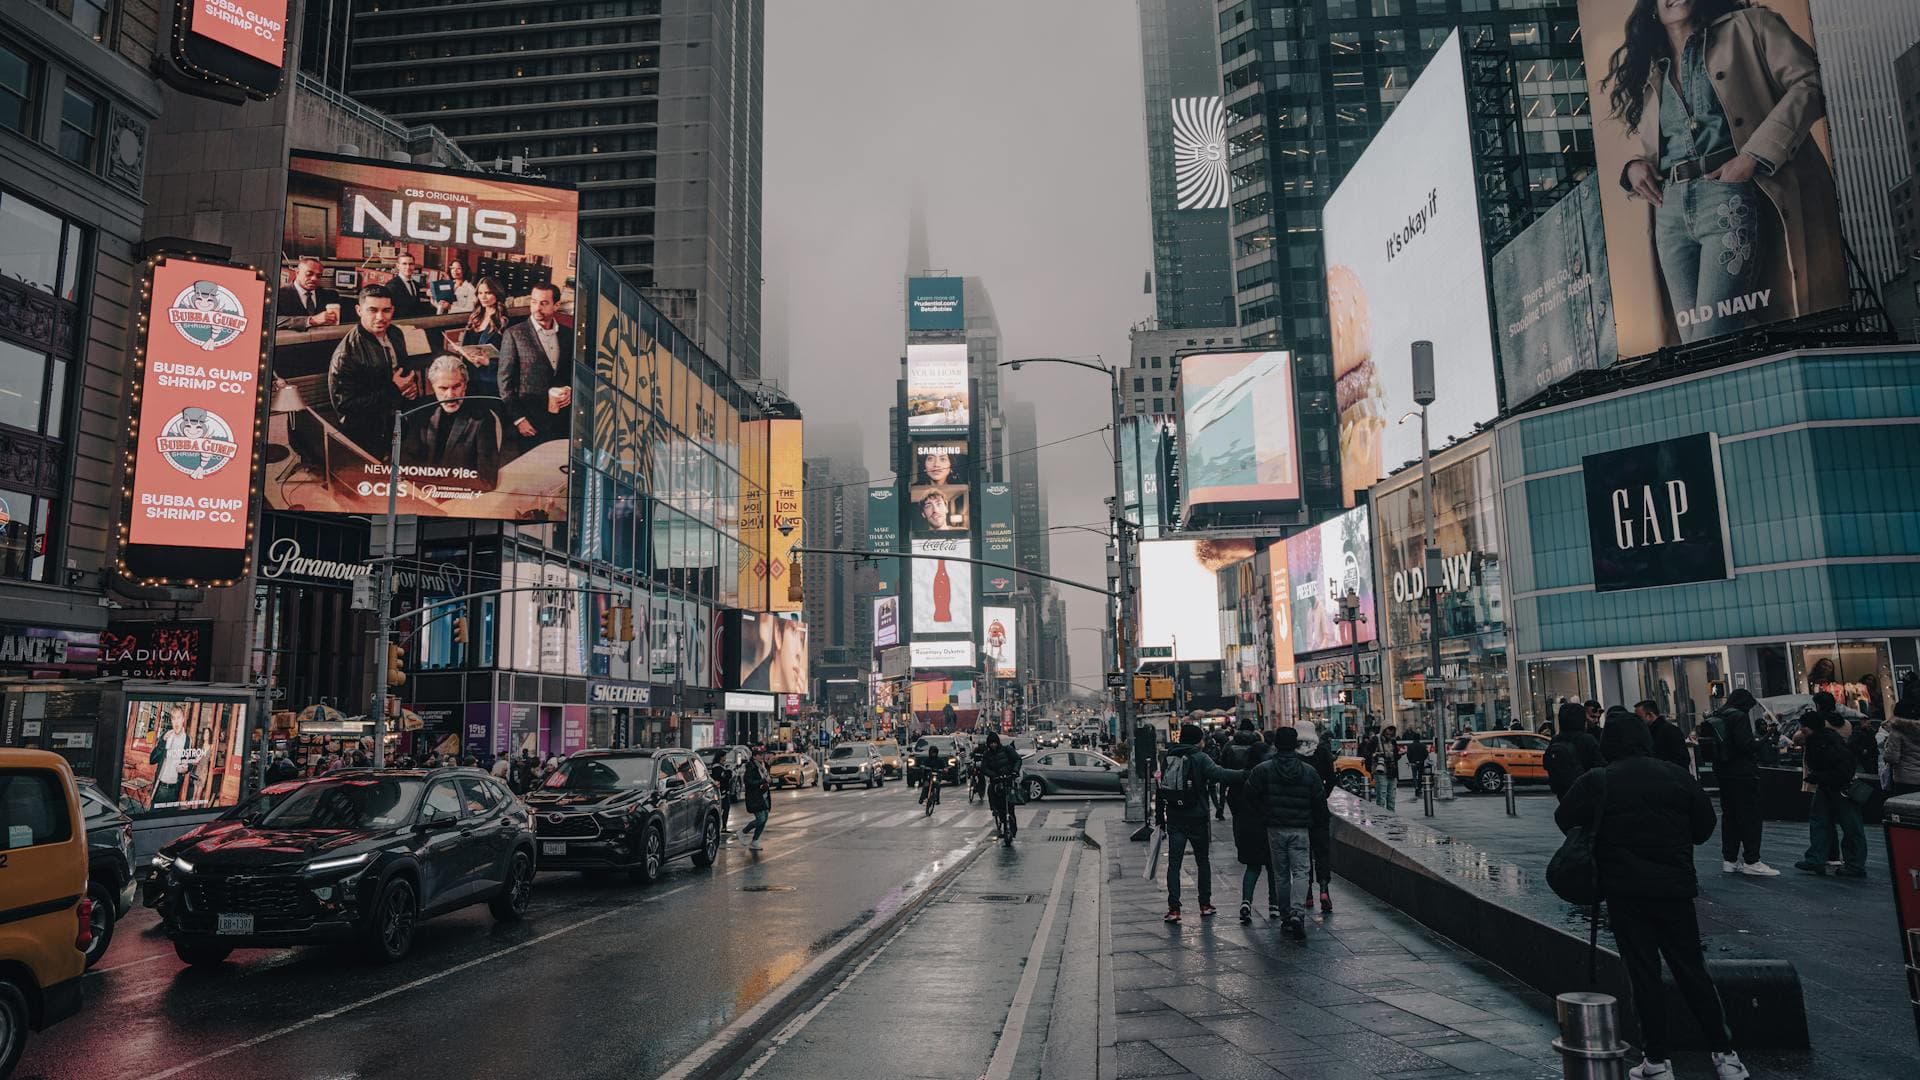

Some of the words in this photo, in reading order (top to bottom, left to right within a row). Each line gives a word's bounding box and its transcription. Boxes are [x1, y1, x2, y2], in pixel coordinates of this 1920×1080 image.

[205, 0, 244, 17] UBBA
[246, 10, 281, 32] GUMP
[205, 4, 252, 30] SHRIMP
[254, 26, 274, 41] CO.
[405, 189, 424, 198] CBS
[426, 191, 470, 203] ORIGINAL
[352, 194, 517, 249] NCIS
[1386, 232, 1402, 262] It's
[1403, 205, 1427, 244] okay
[1428, 188, 1437, 218] if
[1522, 286, 1543, 308] There
[1543, 278, 1556, 294] We
[1508, 310, 1540, 337] Stopping
[1540, 289, 1567, 318] Traffic
[1676, 305, 1713, 328] OLD
[1717, 289, 1771, 318] NAVY
[171, 309, 211, 324] BUBBA
[212, 312, 246, 329] GUMP
[153, 361, 206, 378] BUBBA
[208, 368, 252, 382] GUMP
[1536, 369, 1552, 386] OLD
[1552, 355, 1574, 377] NAVY
[158, 375, 216, 390] SHRIMP
[219, 381, 245, 394] CO.
[695, 402, 715, 436] THE
[160, 439, 200, 451] BUBBA
[201, 440, 235, 456] GUMP
[917, 446, 960, 455] SAMSUNG
[364, 464, 392, 475] NEW
[398, 465, 450, 477] MONDAY
[141, 493, 195, 508] BUBBA
[198, 497, 243, 510] GUMP
[776, 501, 797, 512] LION
[146, 506, 206, 521] SHRIMP
[208, 511, 236, 523] CO.
[773, 515, 800, 529] KING
[1612, 480, 1688, 550] GAP
[263, 538, 374, 580] Paramount
[1394, 567, 1423, 603] OLD
[1426, 551, 1473, 597] AVY
[97, 649, 191, 661] LADIUM
[122, 669, 190, 677] SQUARE
[1441, 663, 1460, 679] NAVY
[593, 685, 650, 703] SKECHERS
[6, 700, 17, 744] Newsstand
